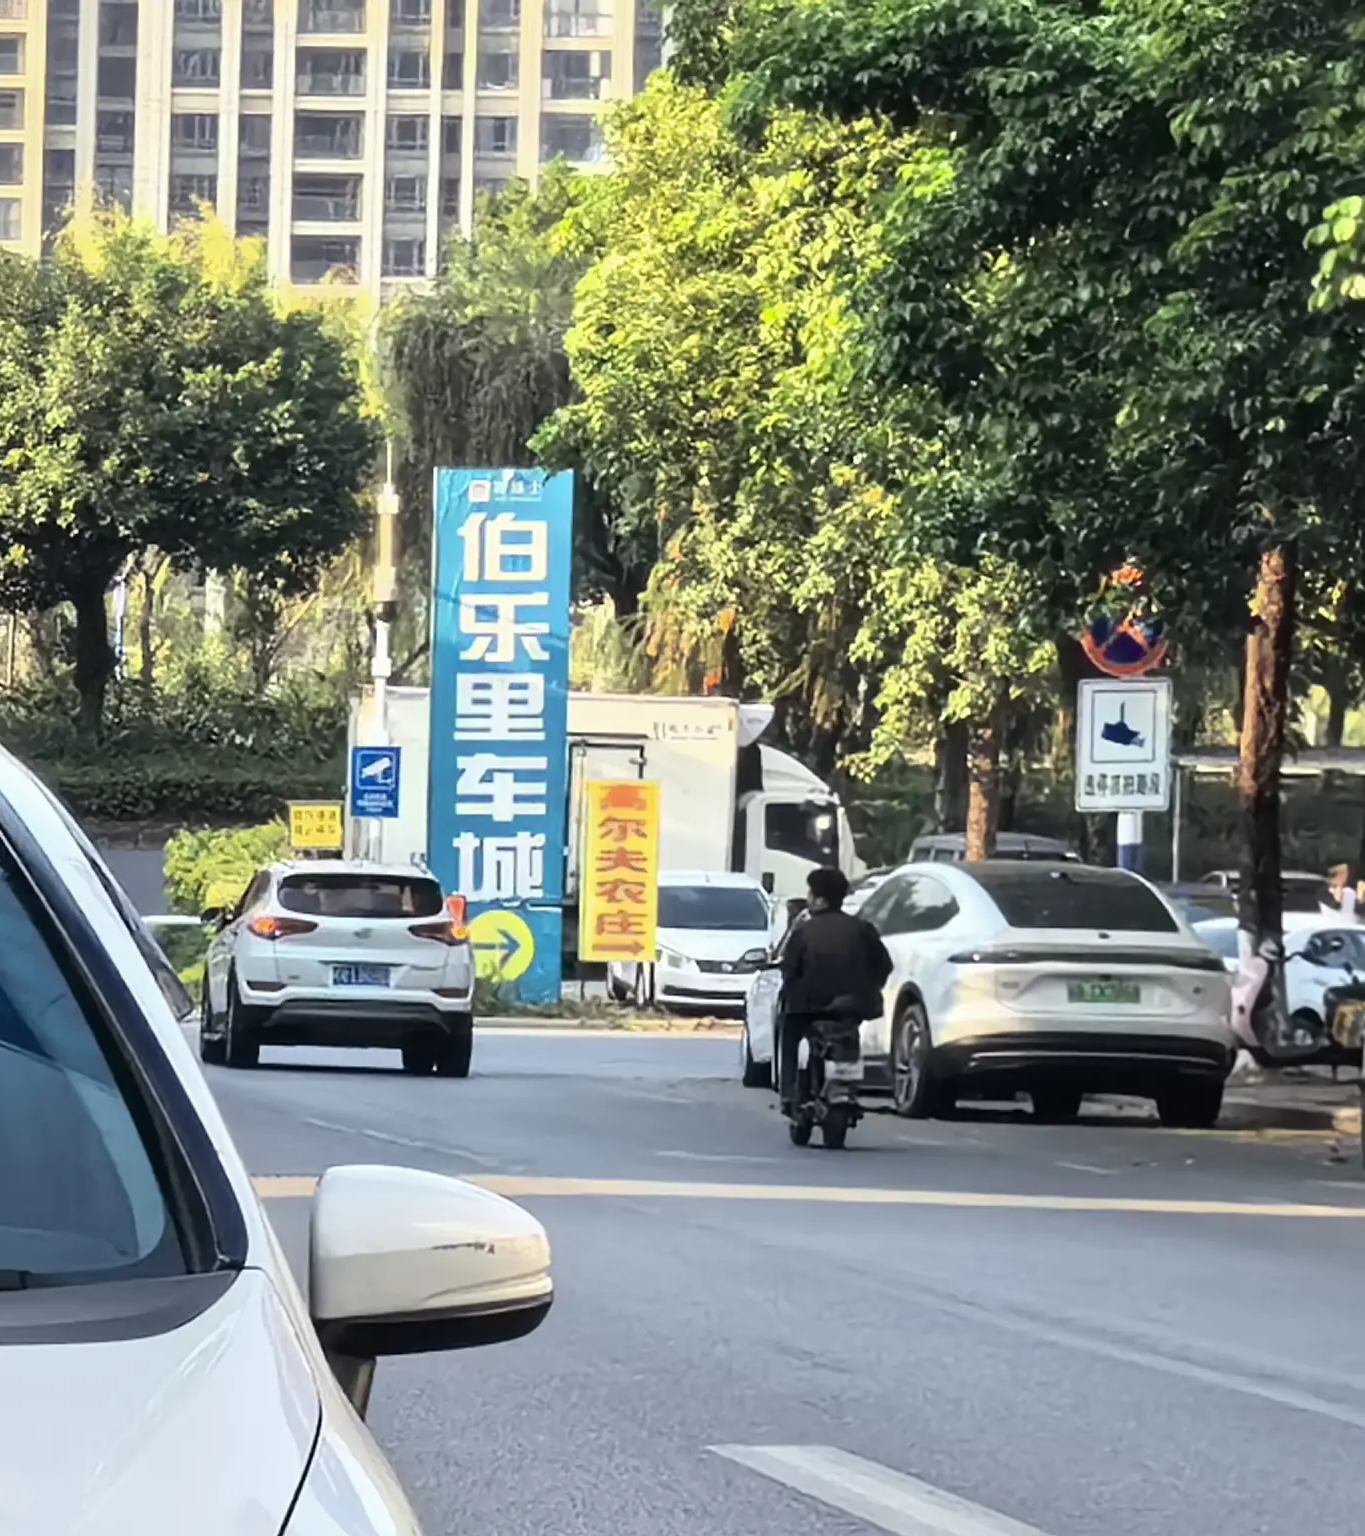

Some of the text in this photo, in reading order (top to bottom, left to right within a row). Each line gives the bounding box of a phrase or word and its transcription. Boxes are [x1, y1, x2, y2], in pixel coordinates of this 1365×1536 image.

[452, 512, 550, 901] 伯乐里车城
[595, 783, 648, 936] 高尔夫农庄
